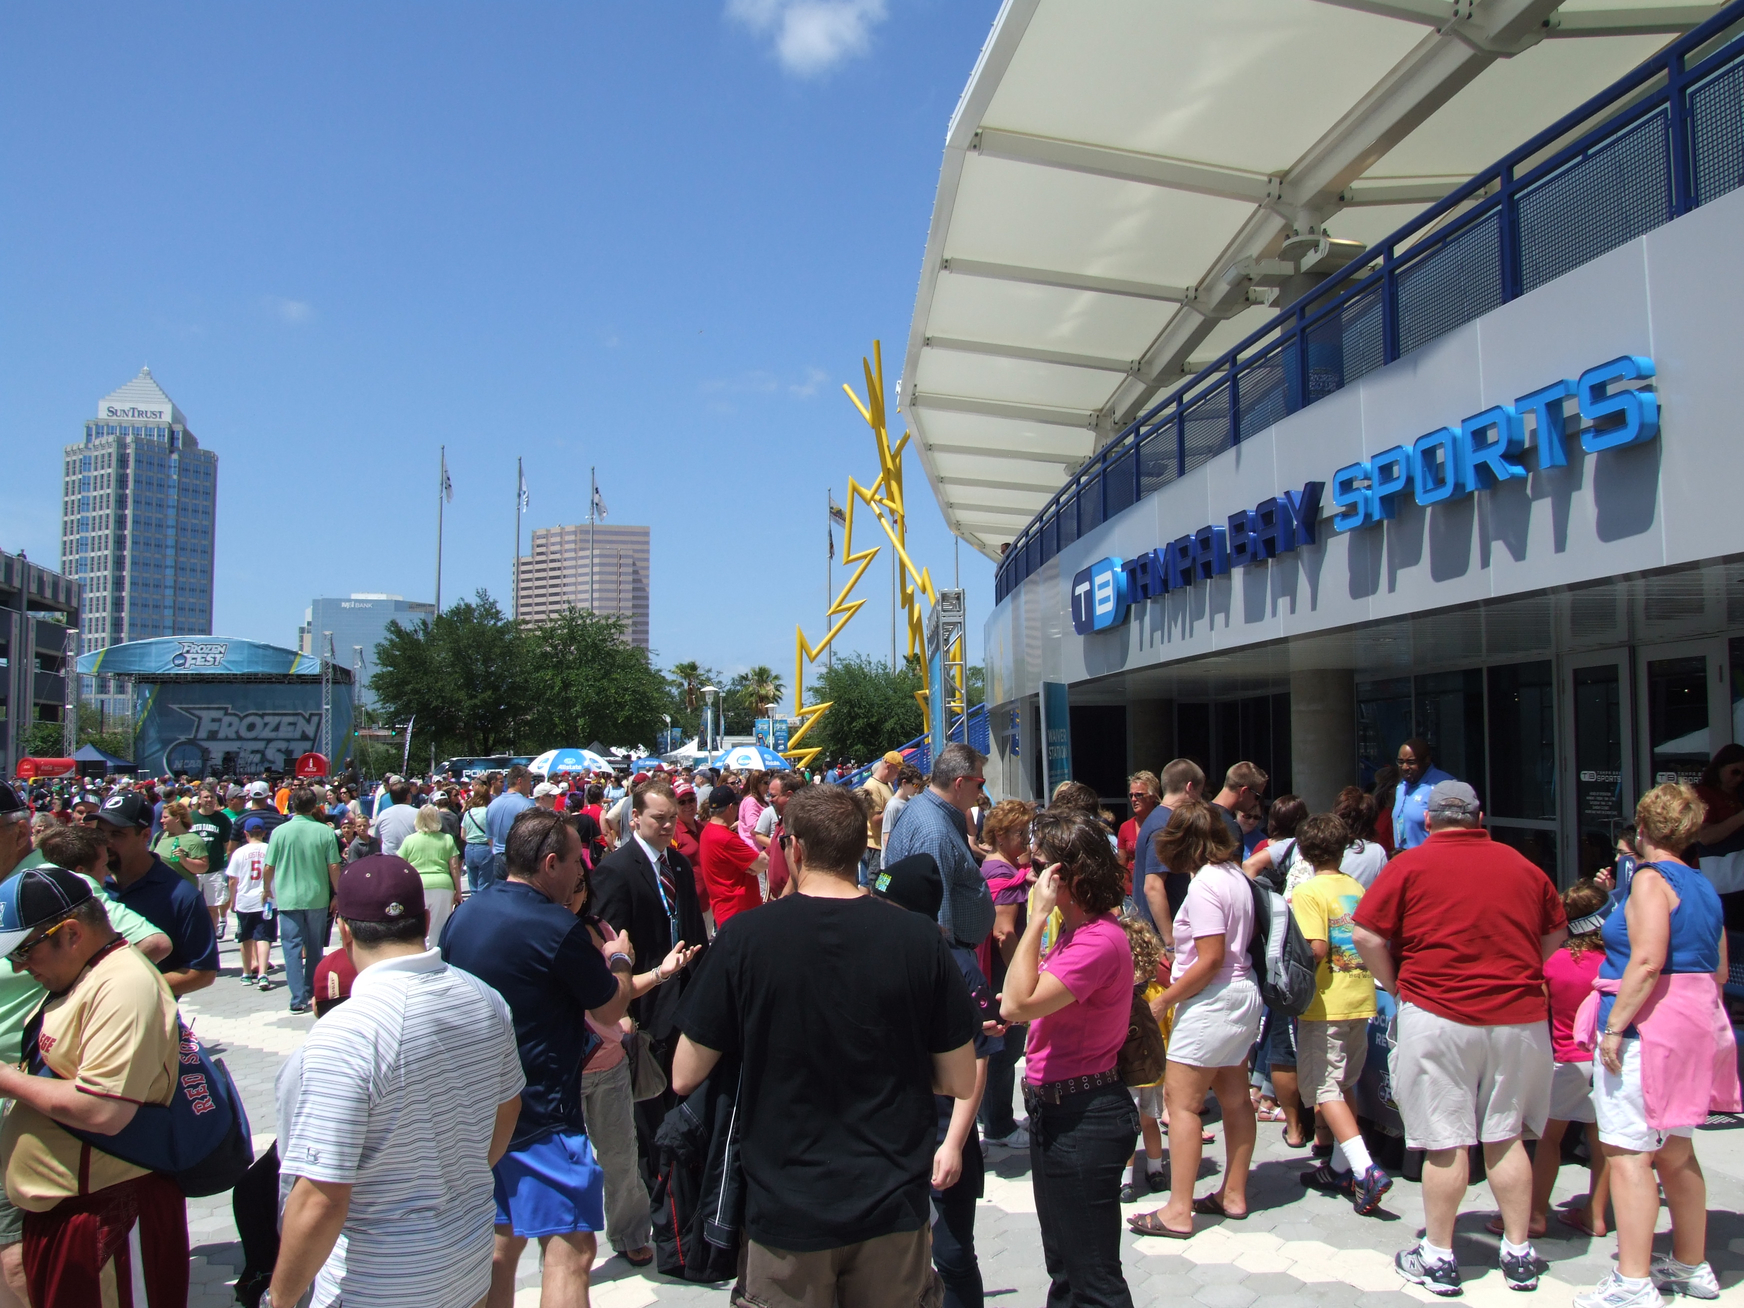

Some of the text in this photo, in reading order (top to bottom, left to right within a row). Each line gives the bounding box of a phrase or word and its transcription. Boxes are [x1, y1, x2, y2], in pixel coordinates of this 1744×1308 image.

[106, 406, 164, 419] SUNTRUST
[1121, 524, 1229, 605] TAMPA
[1228, 481, 1326, 569] BAY
[1333, 355, 1659, 533] SPORTS
[181, 642, 226, 654] FROZEN
[183, 653, 224, 669] FEST
[188, 709, 320, 739] FROZEN
[1047, 728, 1067, 743] WAIVER
[1048, 745, 1069, 760] STATION
[173, 758, 202, 769] NCAA
[1597, 775, 1621, 783] SPORTS
[251, 860, 262, 881] 5
[181, 1072, 217, 1116] RED
